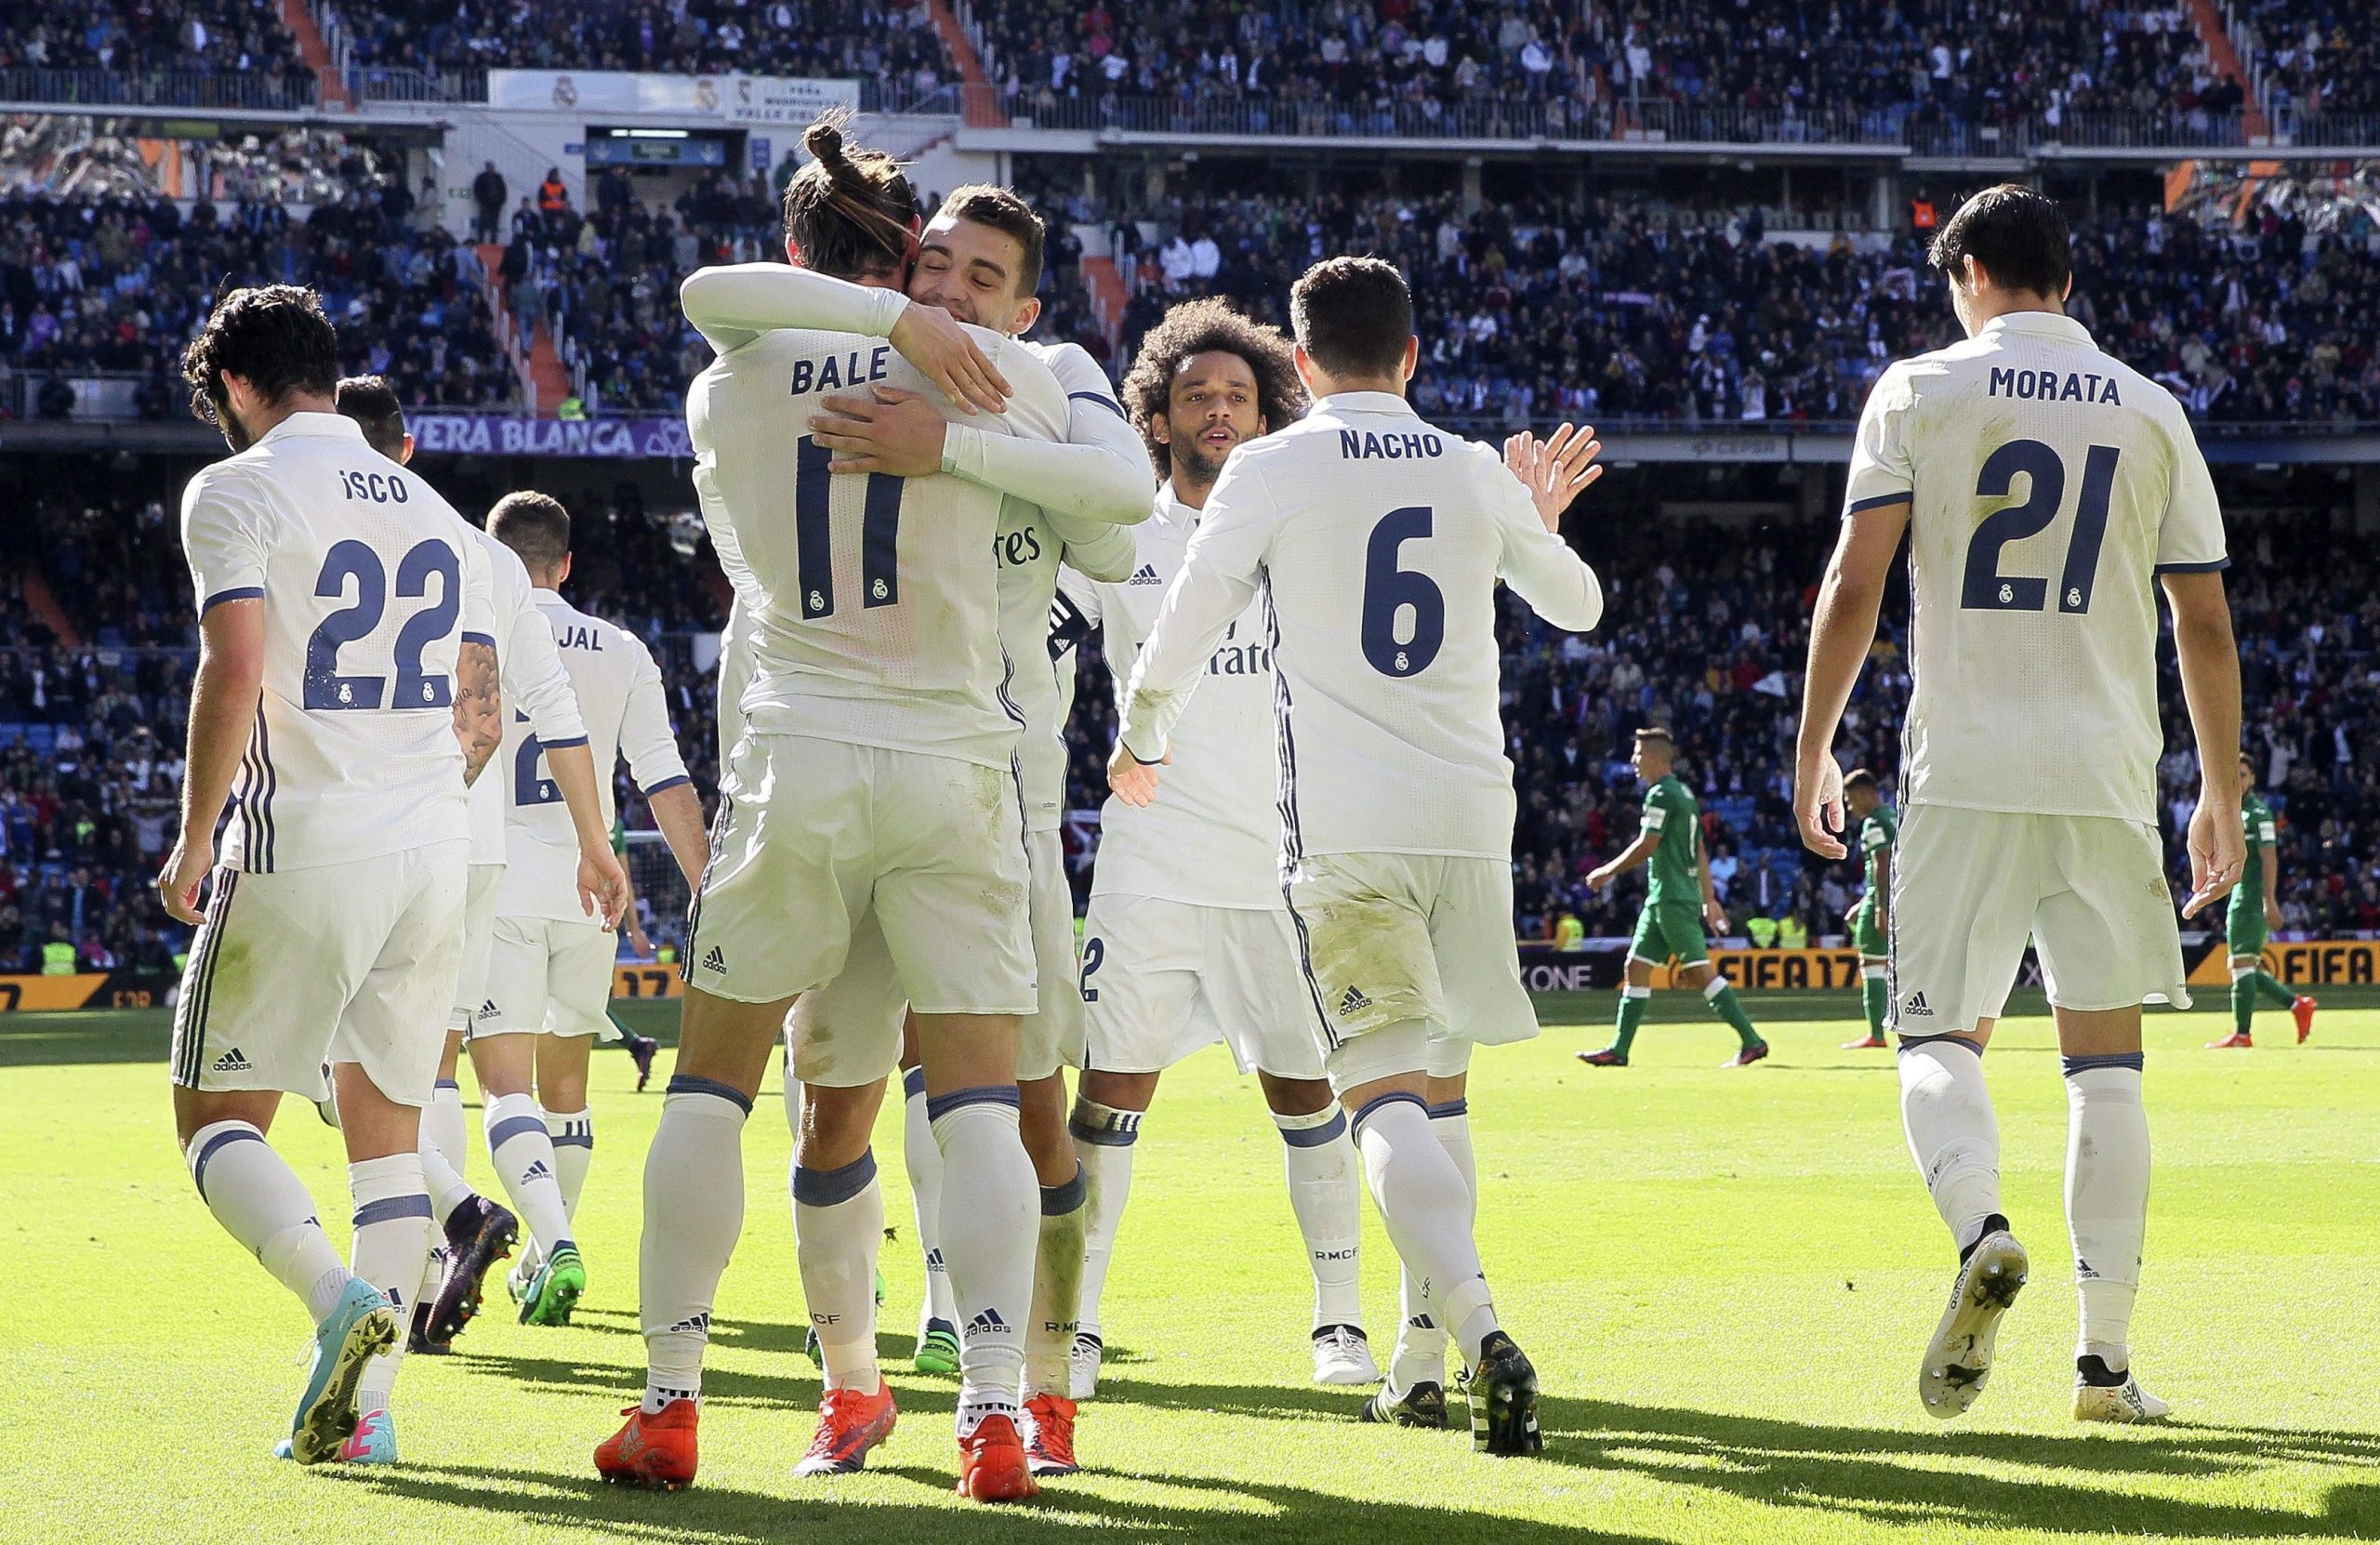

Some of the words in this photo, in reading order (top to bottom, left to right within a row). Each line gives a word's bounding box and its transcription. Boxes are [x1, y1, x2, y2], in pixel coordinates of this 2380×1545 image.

[791, 346, 890, 395] BALE
[1989, 367, 2122, 406] MORATA
[500, 419, 636, 455] BLANCA
[1340, 429, 1444, 460] NACHO
[796, 433, 906, 620] 11
[1960, 439, 2121, 614] 21
[1361, 507, 1445, 678] 6
[303, 538, 461, 709] 22
[559, 626, 603, 652] JAL
[702, 959, 727, 975] adidas
[1079, 937, 1104, 1002] 2
[1719, 956, 1810, 989] FIFA
[1815, 956, 1859, 988] 17
[2285, 948, 2373, 984] FIFA
[623, 971, 670, 997] 17
[1340, 997, 1372, 1016] adidas
[1315, 1246, 1359, 1261] RMCF
[1950, 1260, 1972, 1309] adidas
[810, 1311, 840, 1325] CF
[965, 1324, 1012, 1339] adidas
[2122, 1389, 2146, 1418] adidas
